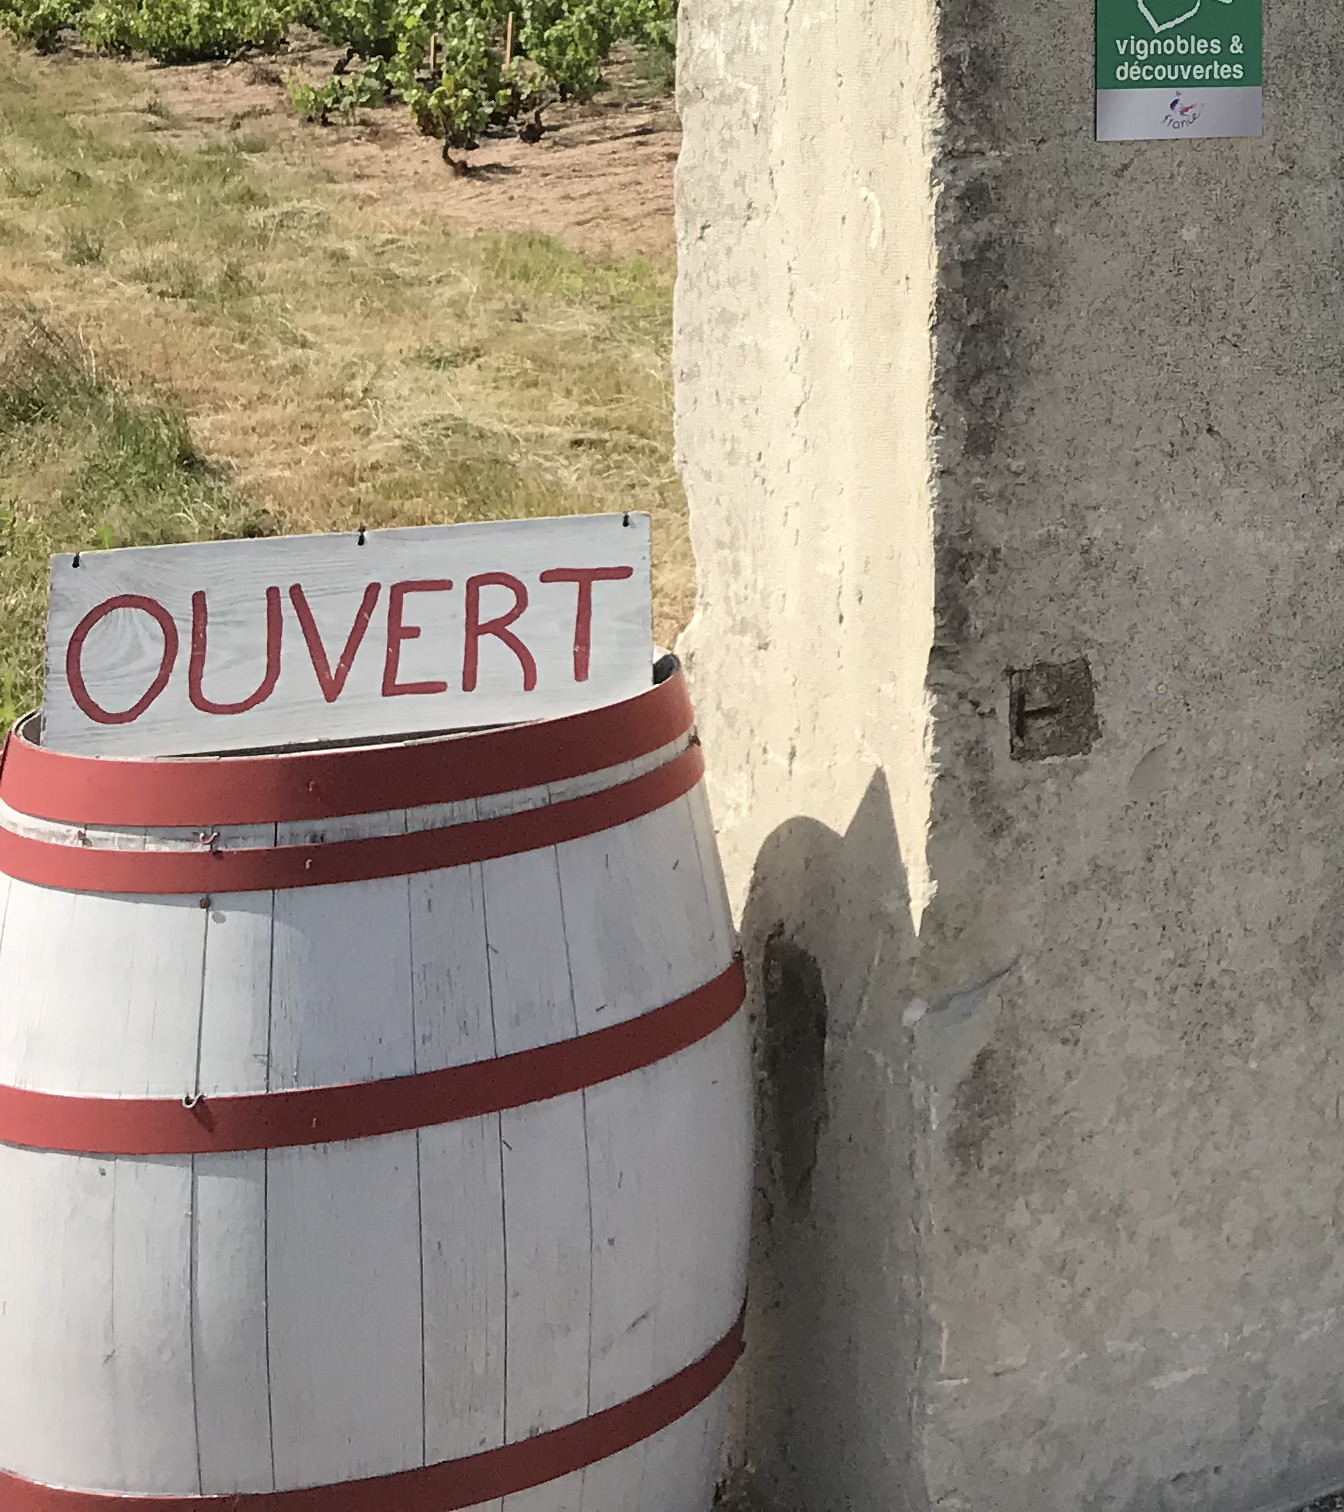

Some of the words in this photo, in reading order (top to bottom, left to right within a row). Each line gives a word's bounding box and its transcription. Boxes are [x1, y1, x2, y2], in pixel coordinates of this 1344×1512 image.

[1115, 35, 1222, 60] vignobles
[1229, 35, 1244, 55] &
[1115, 60, 1244, 81] découvertes
[66, 565, 634, 726] OUVERT
